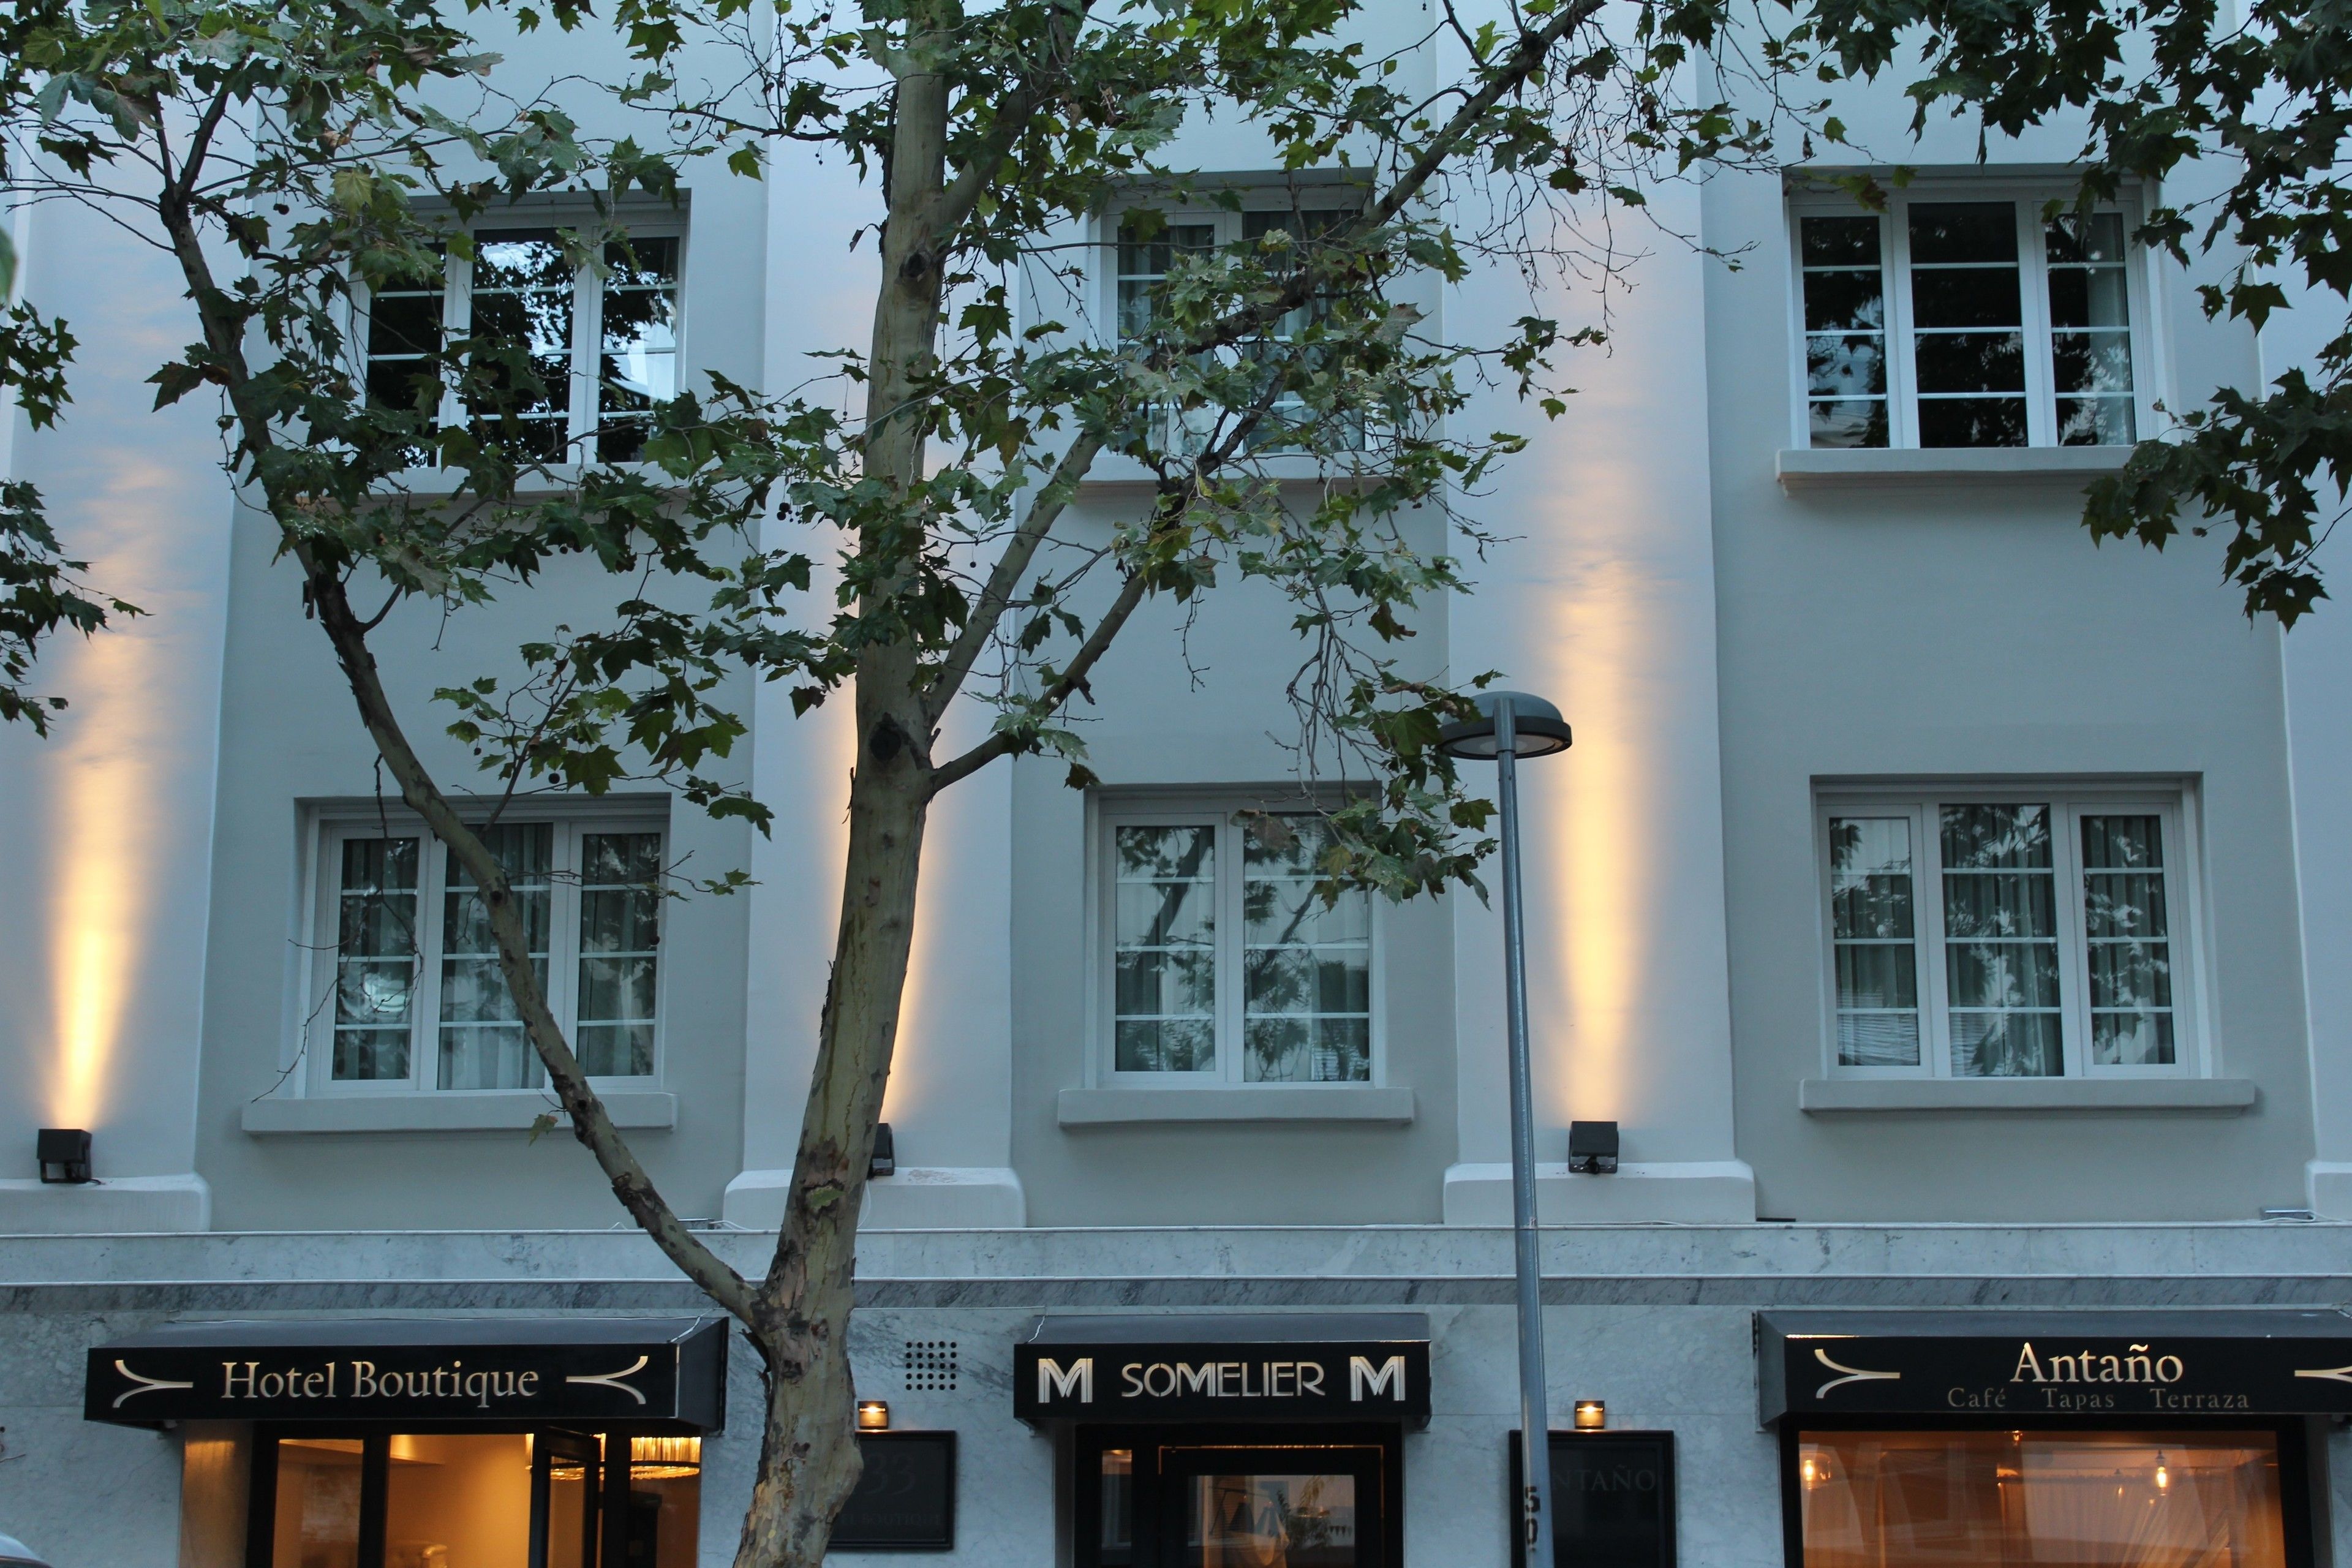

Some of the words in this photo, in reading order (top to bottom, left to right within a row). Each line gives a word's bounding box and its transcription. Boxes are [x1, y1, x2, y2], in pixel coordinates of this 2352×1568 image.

[1038, 1358, 1093, 1404] M
[1121, 1362, 1326, 1398] SOMELIER
[1349, 1356, 1406, 1401] M
[2010, 1342, 2184, 1383] Antaño
[221, 1361, 336, 1398] Hotel
[350, 1360, 539, 1408] Boutique
[1947, 1387, 2007, 1408] Café
[2041, 1387, 2115, 1410] Tapas
[2149, 1387, 2250, 1409] Terraza
[864, 1452, 916, 1496] 33
[1550, 1463, 1656, 1492] NTAÑO
